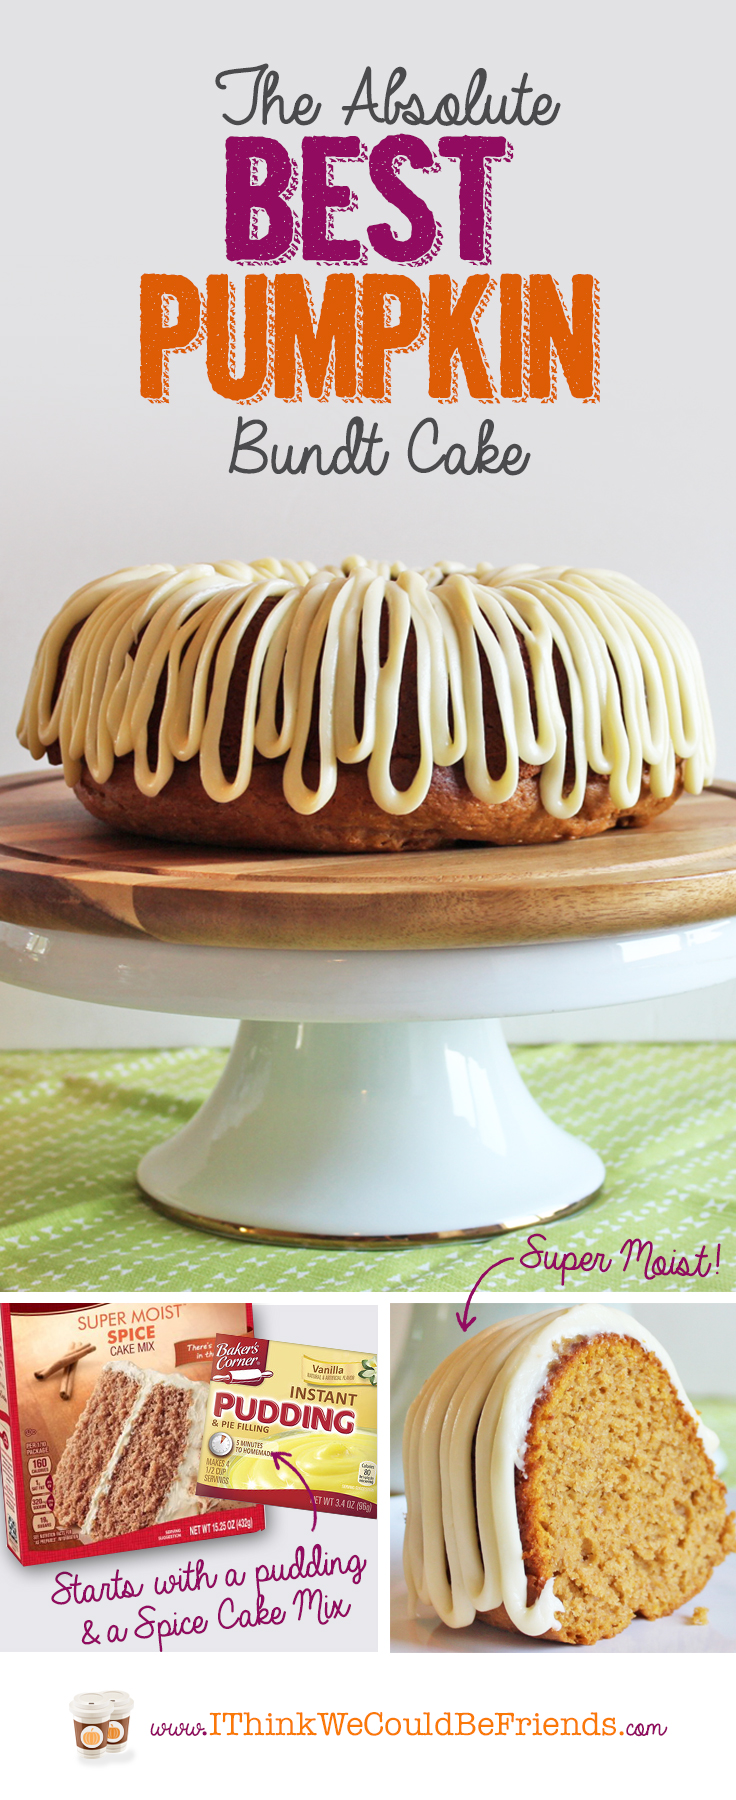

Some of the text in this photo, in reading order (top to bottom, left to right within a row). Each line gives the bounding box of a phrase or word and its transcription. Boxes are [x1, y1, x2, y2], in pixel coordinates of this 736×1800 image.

[78, 1311, 126, 1331] SUPER
[107, 1325, 155, 1344] SPICE
[110, 1341, 155, 1357] CAKE MIX
[187, 1342, 212, 1352] There's
[216, 1342, 259, 1357] Baker's
[313, 1364, 344, 1375] Vanilla
[290, 1386, 358, 1406] INSTANT
[213, 1391, 356, 1435] PUDDING
[211, 1419, 270, 1433] & PIE FILLING
[240, 1440, 263, 1449] MINUTES
[32, 1458, 47, 1468] 160
[206, 1458, 225, 1467] MAKES
[205, 1467, 226, 1475] 1/2 CUP
[204, 1475, 229, 1484] SERVINGS
[323, 1497, 334, 1506] WT
[335, 1499, 345, 1508] 3.4
[346, 1500, 355, 1509] OZ
[356, 1502, 372, 1513] (96g)
[190, 1517, 253, 1536] NET WT 15.25 OZ (432g)
